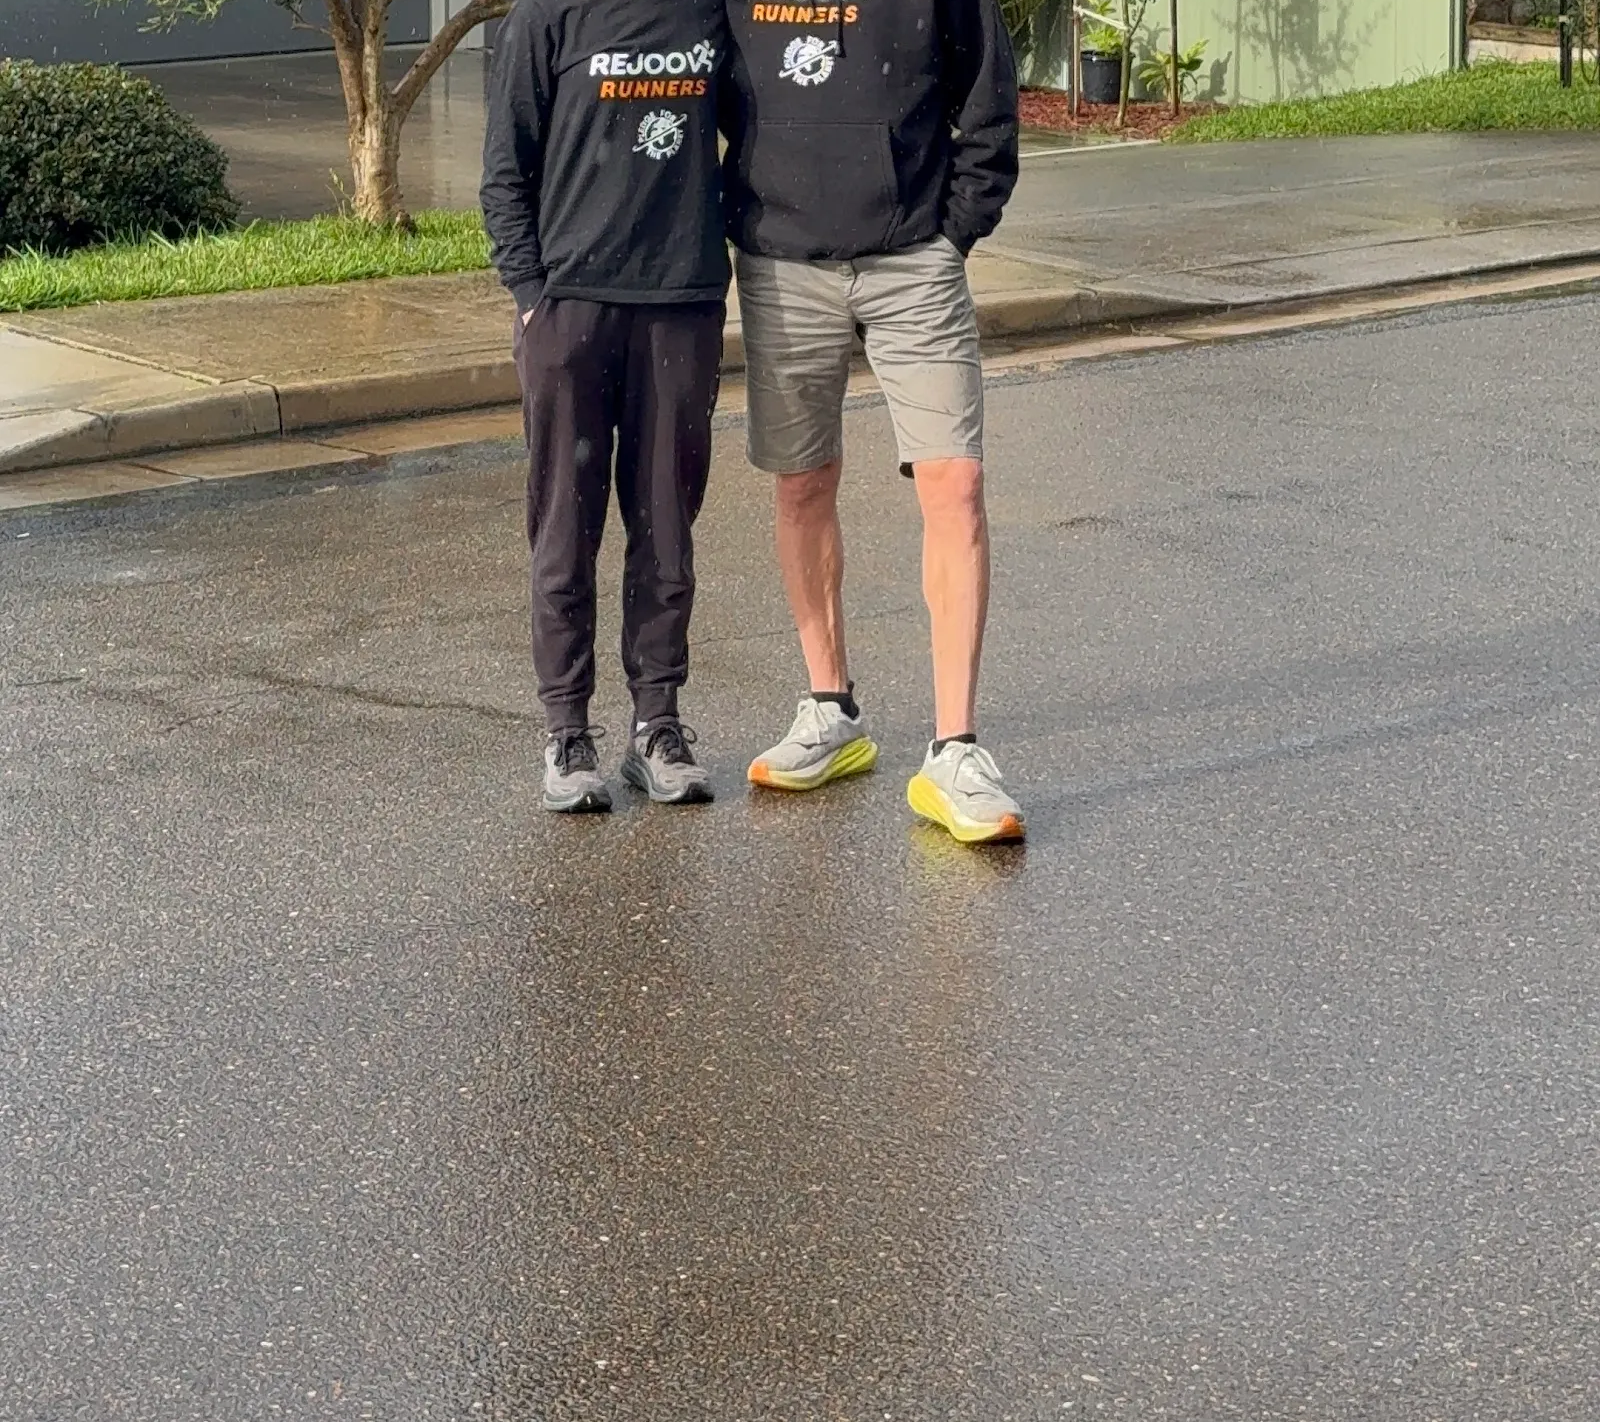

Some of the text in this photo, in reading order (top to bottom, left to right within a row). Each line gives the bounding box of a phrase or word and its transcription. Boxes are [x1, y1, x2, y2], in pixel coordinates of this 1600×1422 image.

[752, 4, 859, 23] RUNNERS
[589, 52, 702, 76] REJOOV
[600, 79, 707, 98] RUNNERS
